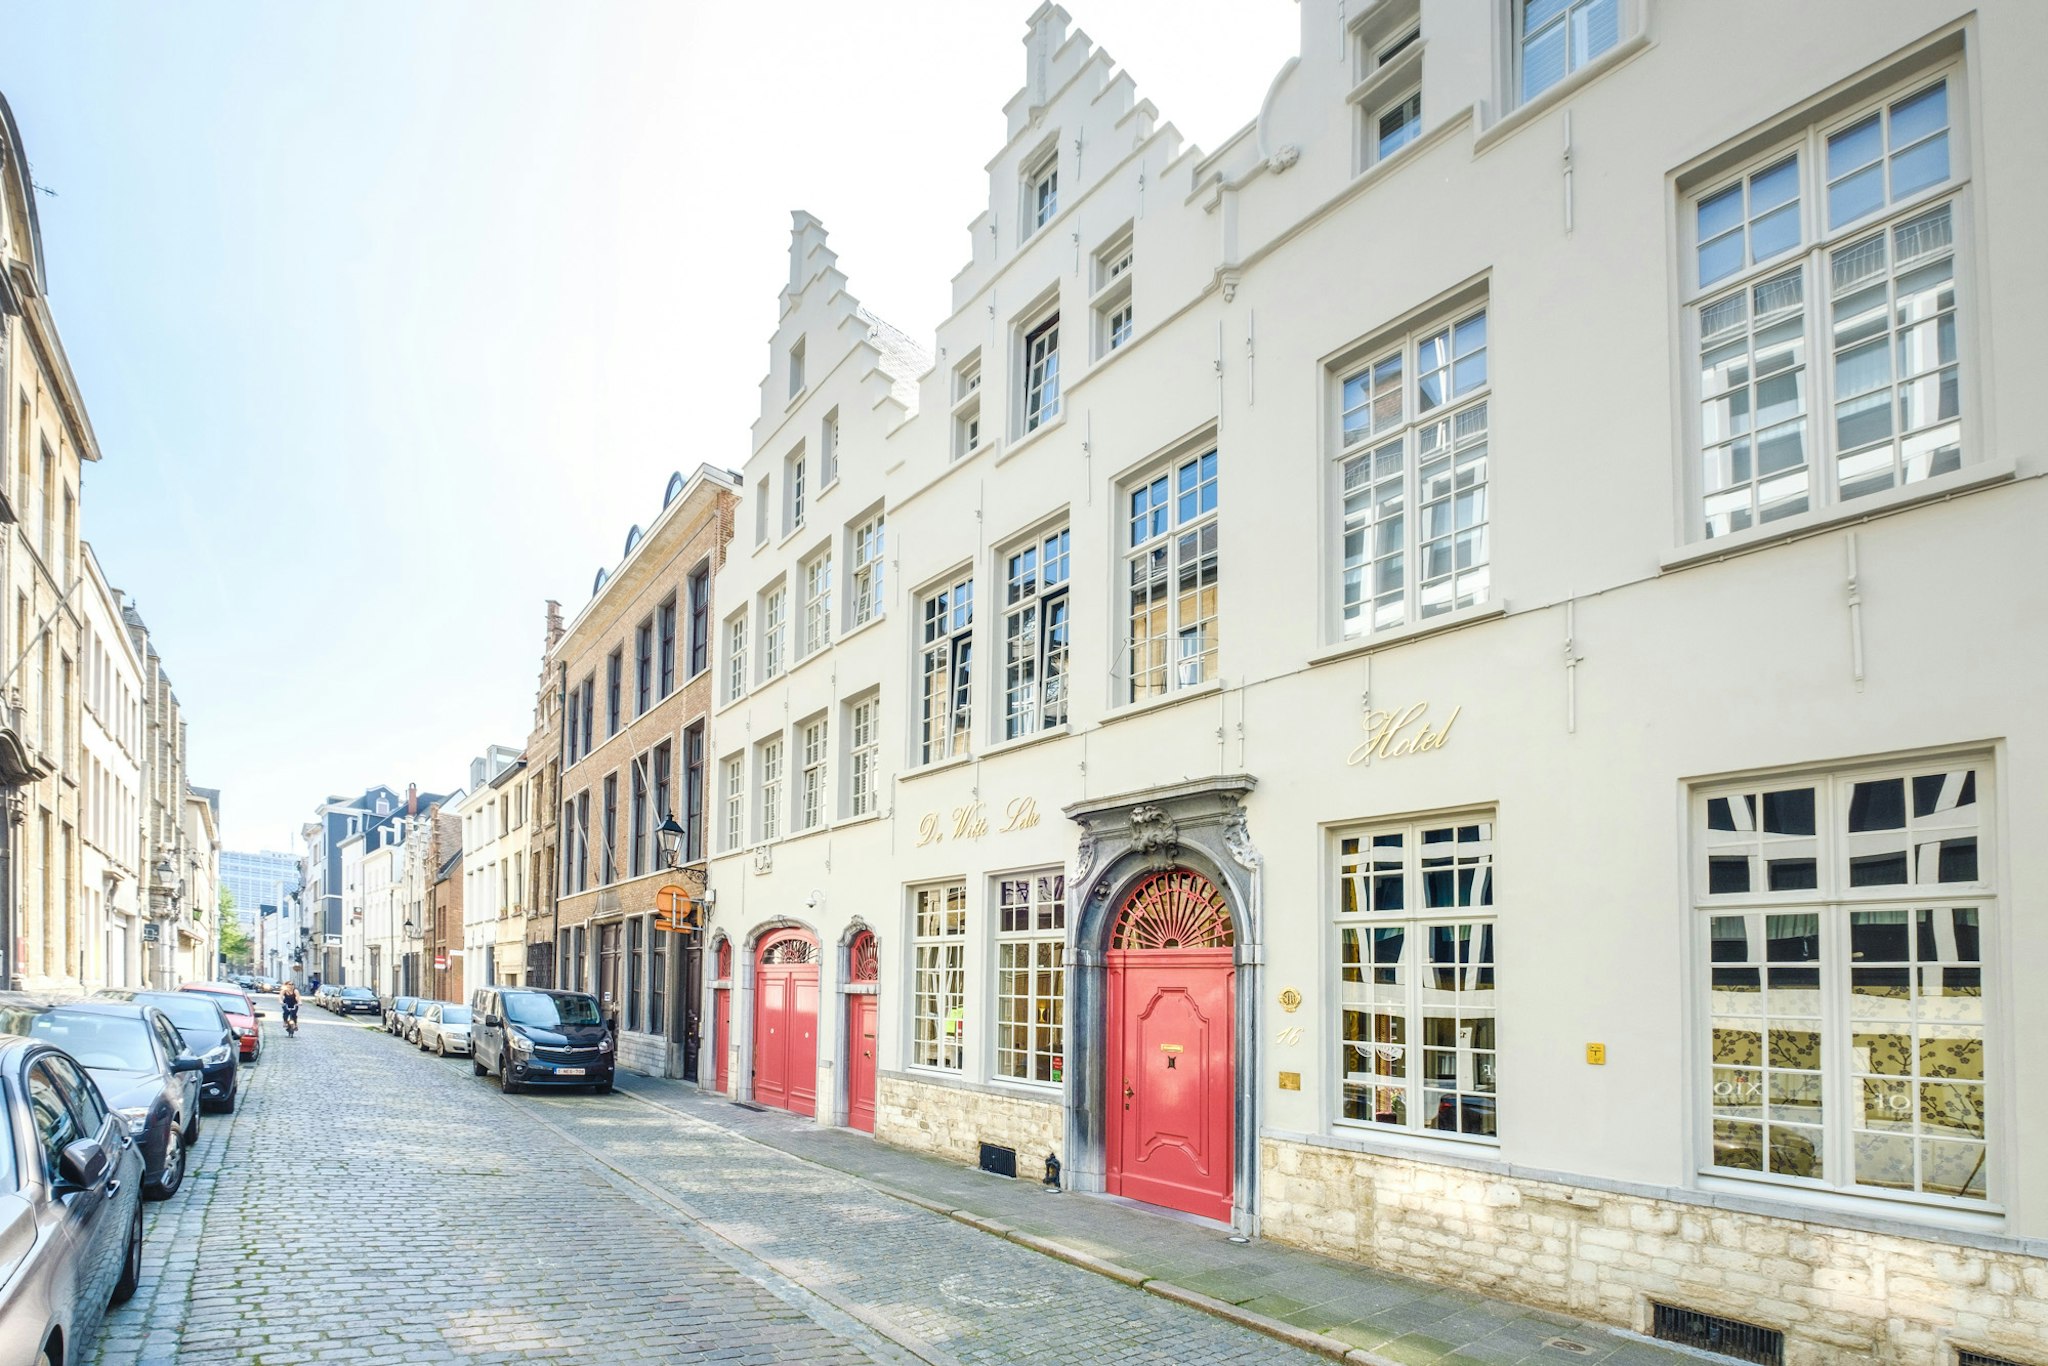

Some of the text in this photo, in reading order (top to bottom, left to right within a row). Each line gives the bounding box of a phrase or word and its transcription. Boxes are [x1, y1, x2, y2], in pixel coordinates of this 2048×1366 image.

[1347, 700, 1462, 766] Hotel
[916, 796, 1041, 848] De Witte Lelie
[1275, 1025, 1304, 1048] 16
